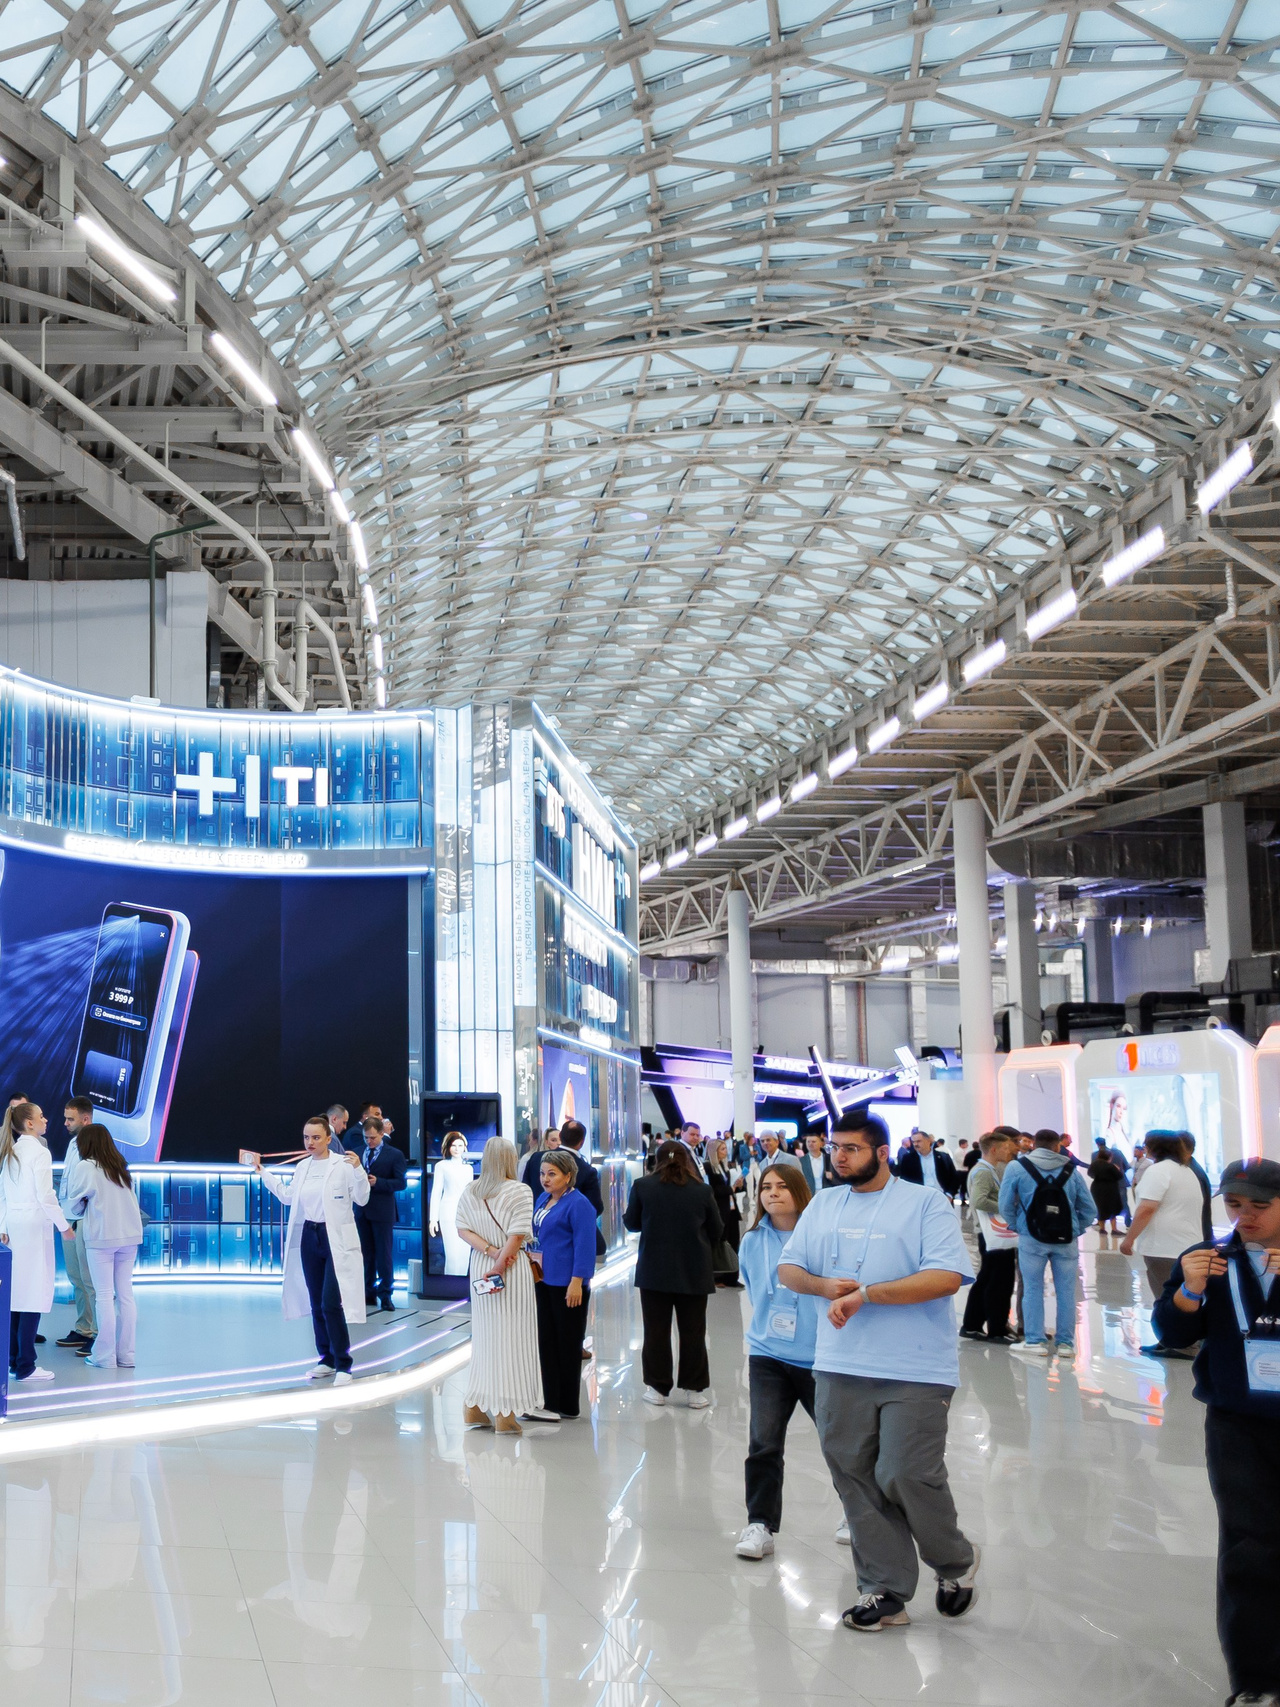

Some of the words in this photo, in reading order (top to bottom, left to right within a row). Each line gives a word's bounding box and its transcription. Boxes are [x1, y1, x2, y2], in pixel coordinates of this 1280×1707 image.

[524, 868, 531, 882] НЕ
[575, 823, 615, 928] НИИ
[524, 885, 533, 917] ДОРОГ
[524, 919, 532, 962] ТЫСЯЧИ
[515, 945, 523, 981] МОЖЕТ
[516, 984, 523, 996] НЕ
